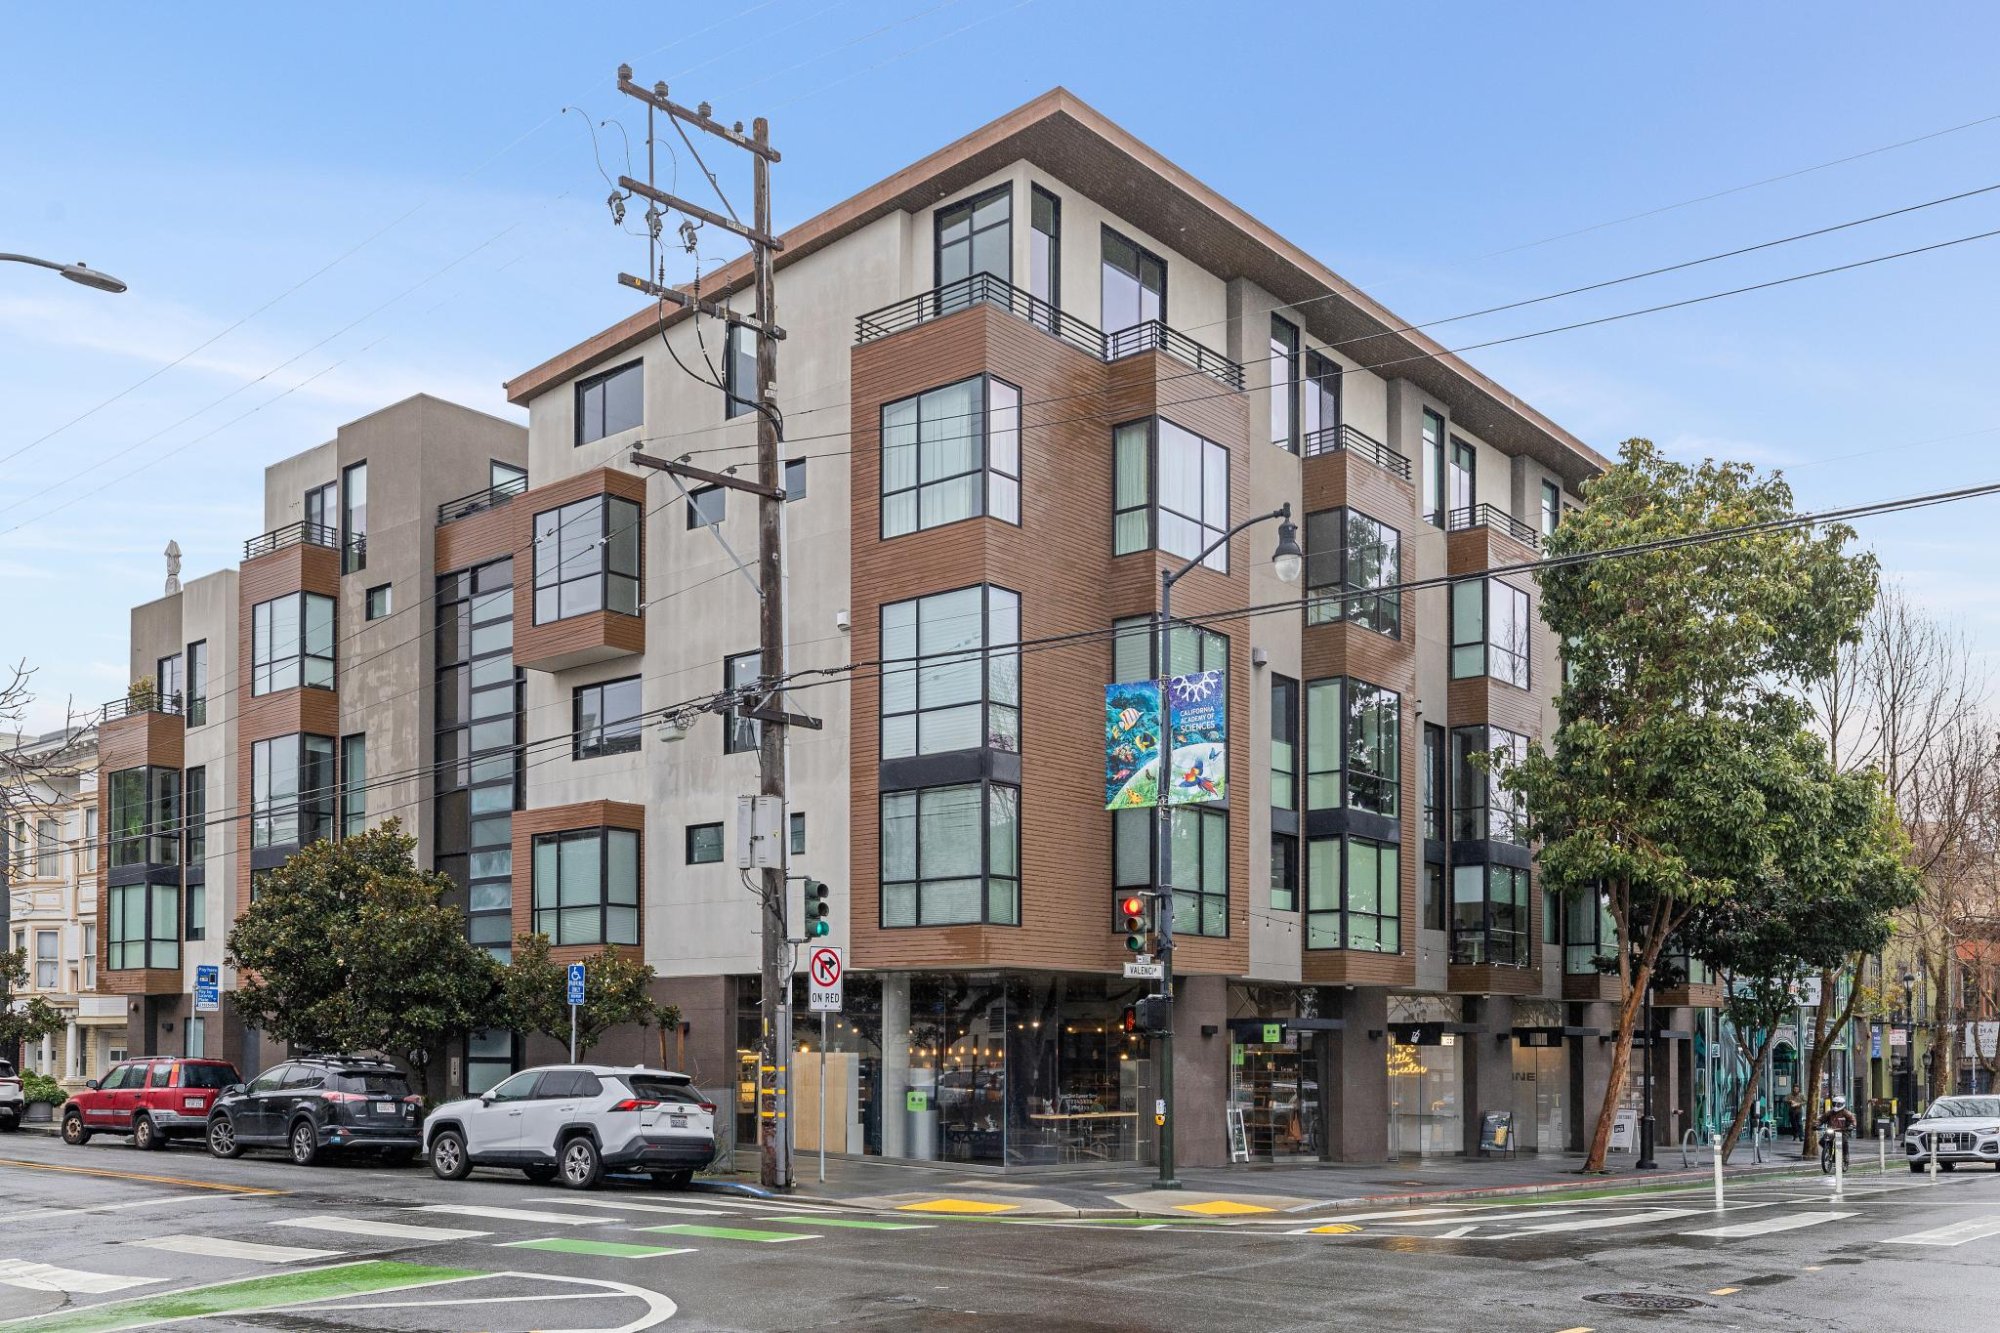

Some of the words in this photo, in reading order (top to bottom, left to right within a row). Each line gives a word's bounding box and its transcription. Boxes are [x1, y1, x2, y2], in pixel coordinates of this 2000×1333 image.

[1180, 706, 1215, 717] CALIFORNIA
[1180, 714, 1206, 724] ACADEMY
[1206, 712, 1215, 721] OF
[1181, 720, 1216, 733] SCIENCES
[812, 993, 823, 1003] ON
[825, 993, 840, 1003] RED
